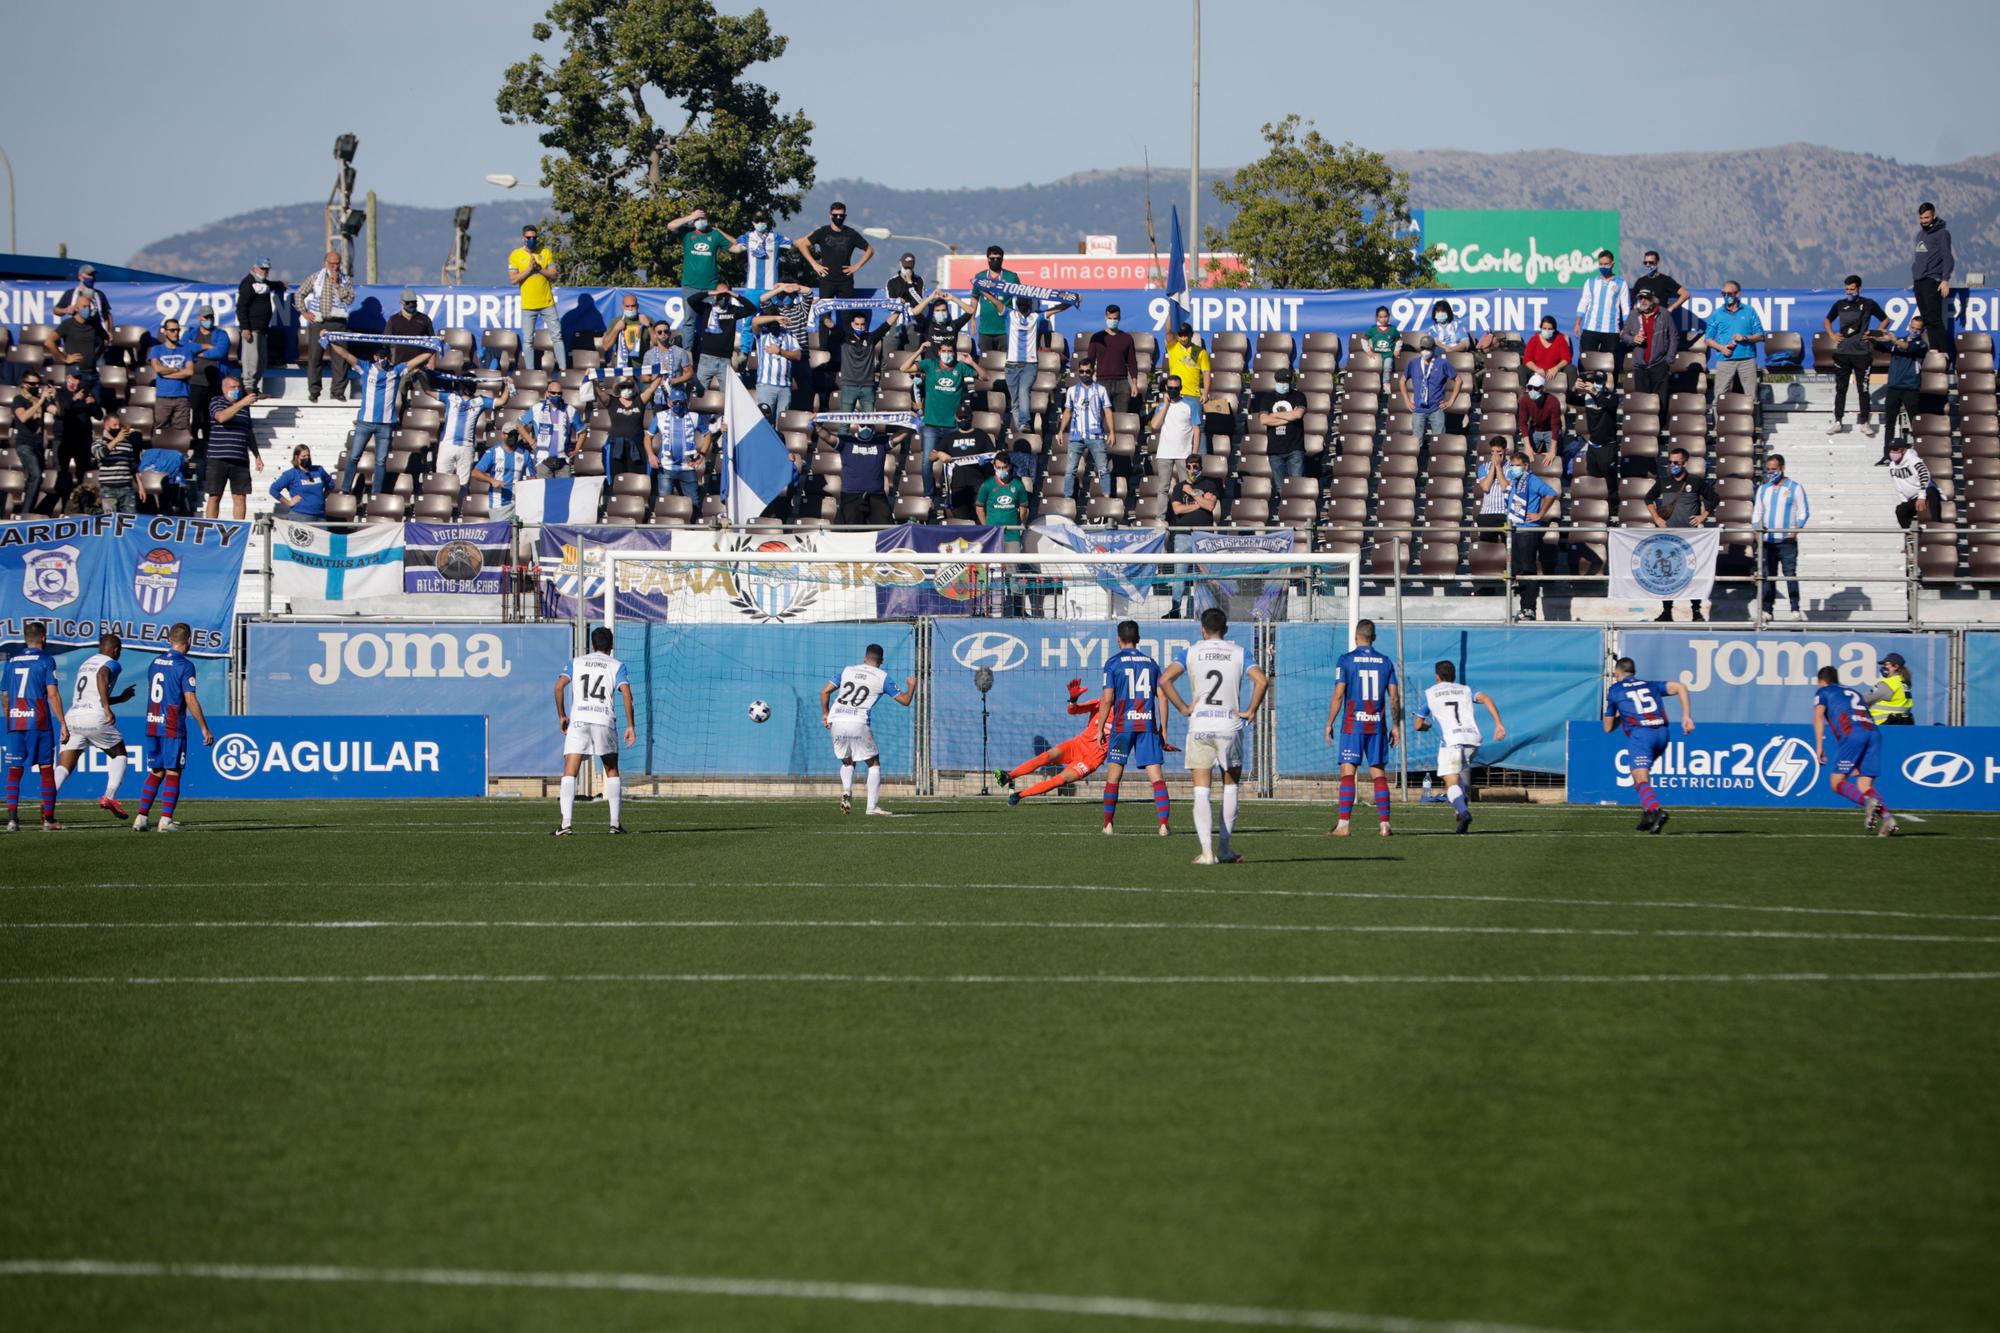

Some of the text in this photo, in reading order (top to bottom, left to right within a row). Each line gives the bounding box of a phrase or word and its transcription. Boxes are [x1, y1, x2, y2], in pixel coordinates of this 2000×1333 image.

[1460, 244, 1524, 274] Corte
[1526, 236, 1604, 285] Inglé
[1002, 281, 1052, 299] TORNAM
[1149, 298, 1303, 331] 91PRINT
[1391, 297, 1548, 332] 97PRINT
[149, 516, 240, 547] CITY
[0, 618, 222, 648] LTICO BALEAES
[309, 633, 511, 685] Joma
[1679, 640, 1881, 692] Joma
[15, 668, 29, 698] 7
[77, 676, 88, 700] 9
[151, 673, 164, 703] 6
[580, 674, 606, 703] 14
[838, 681, 870, 707] 20
[1125, 669, 1151, 699] 14
[1205, 670, 1223, 706] 2
[1359, 670, 1379, 700] 11
[10, 708, 34, 718] fibwi
[1127, 710, 1152, 720] fibwi
[1445, 701, 1462, 726] 7
[1627, 688, 1658, 714] 15
[1844, 690, 1867, 711] 2
[147, 712, 165, 724] ibwi
[1356, 712, 1381, 722] fibwi
[180, 753, 186, 766] 6
[262, 741, 440, 773] AGUILAR
